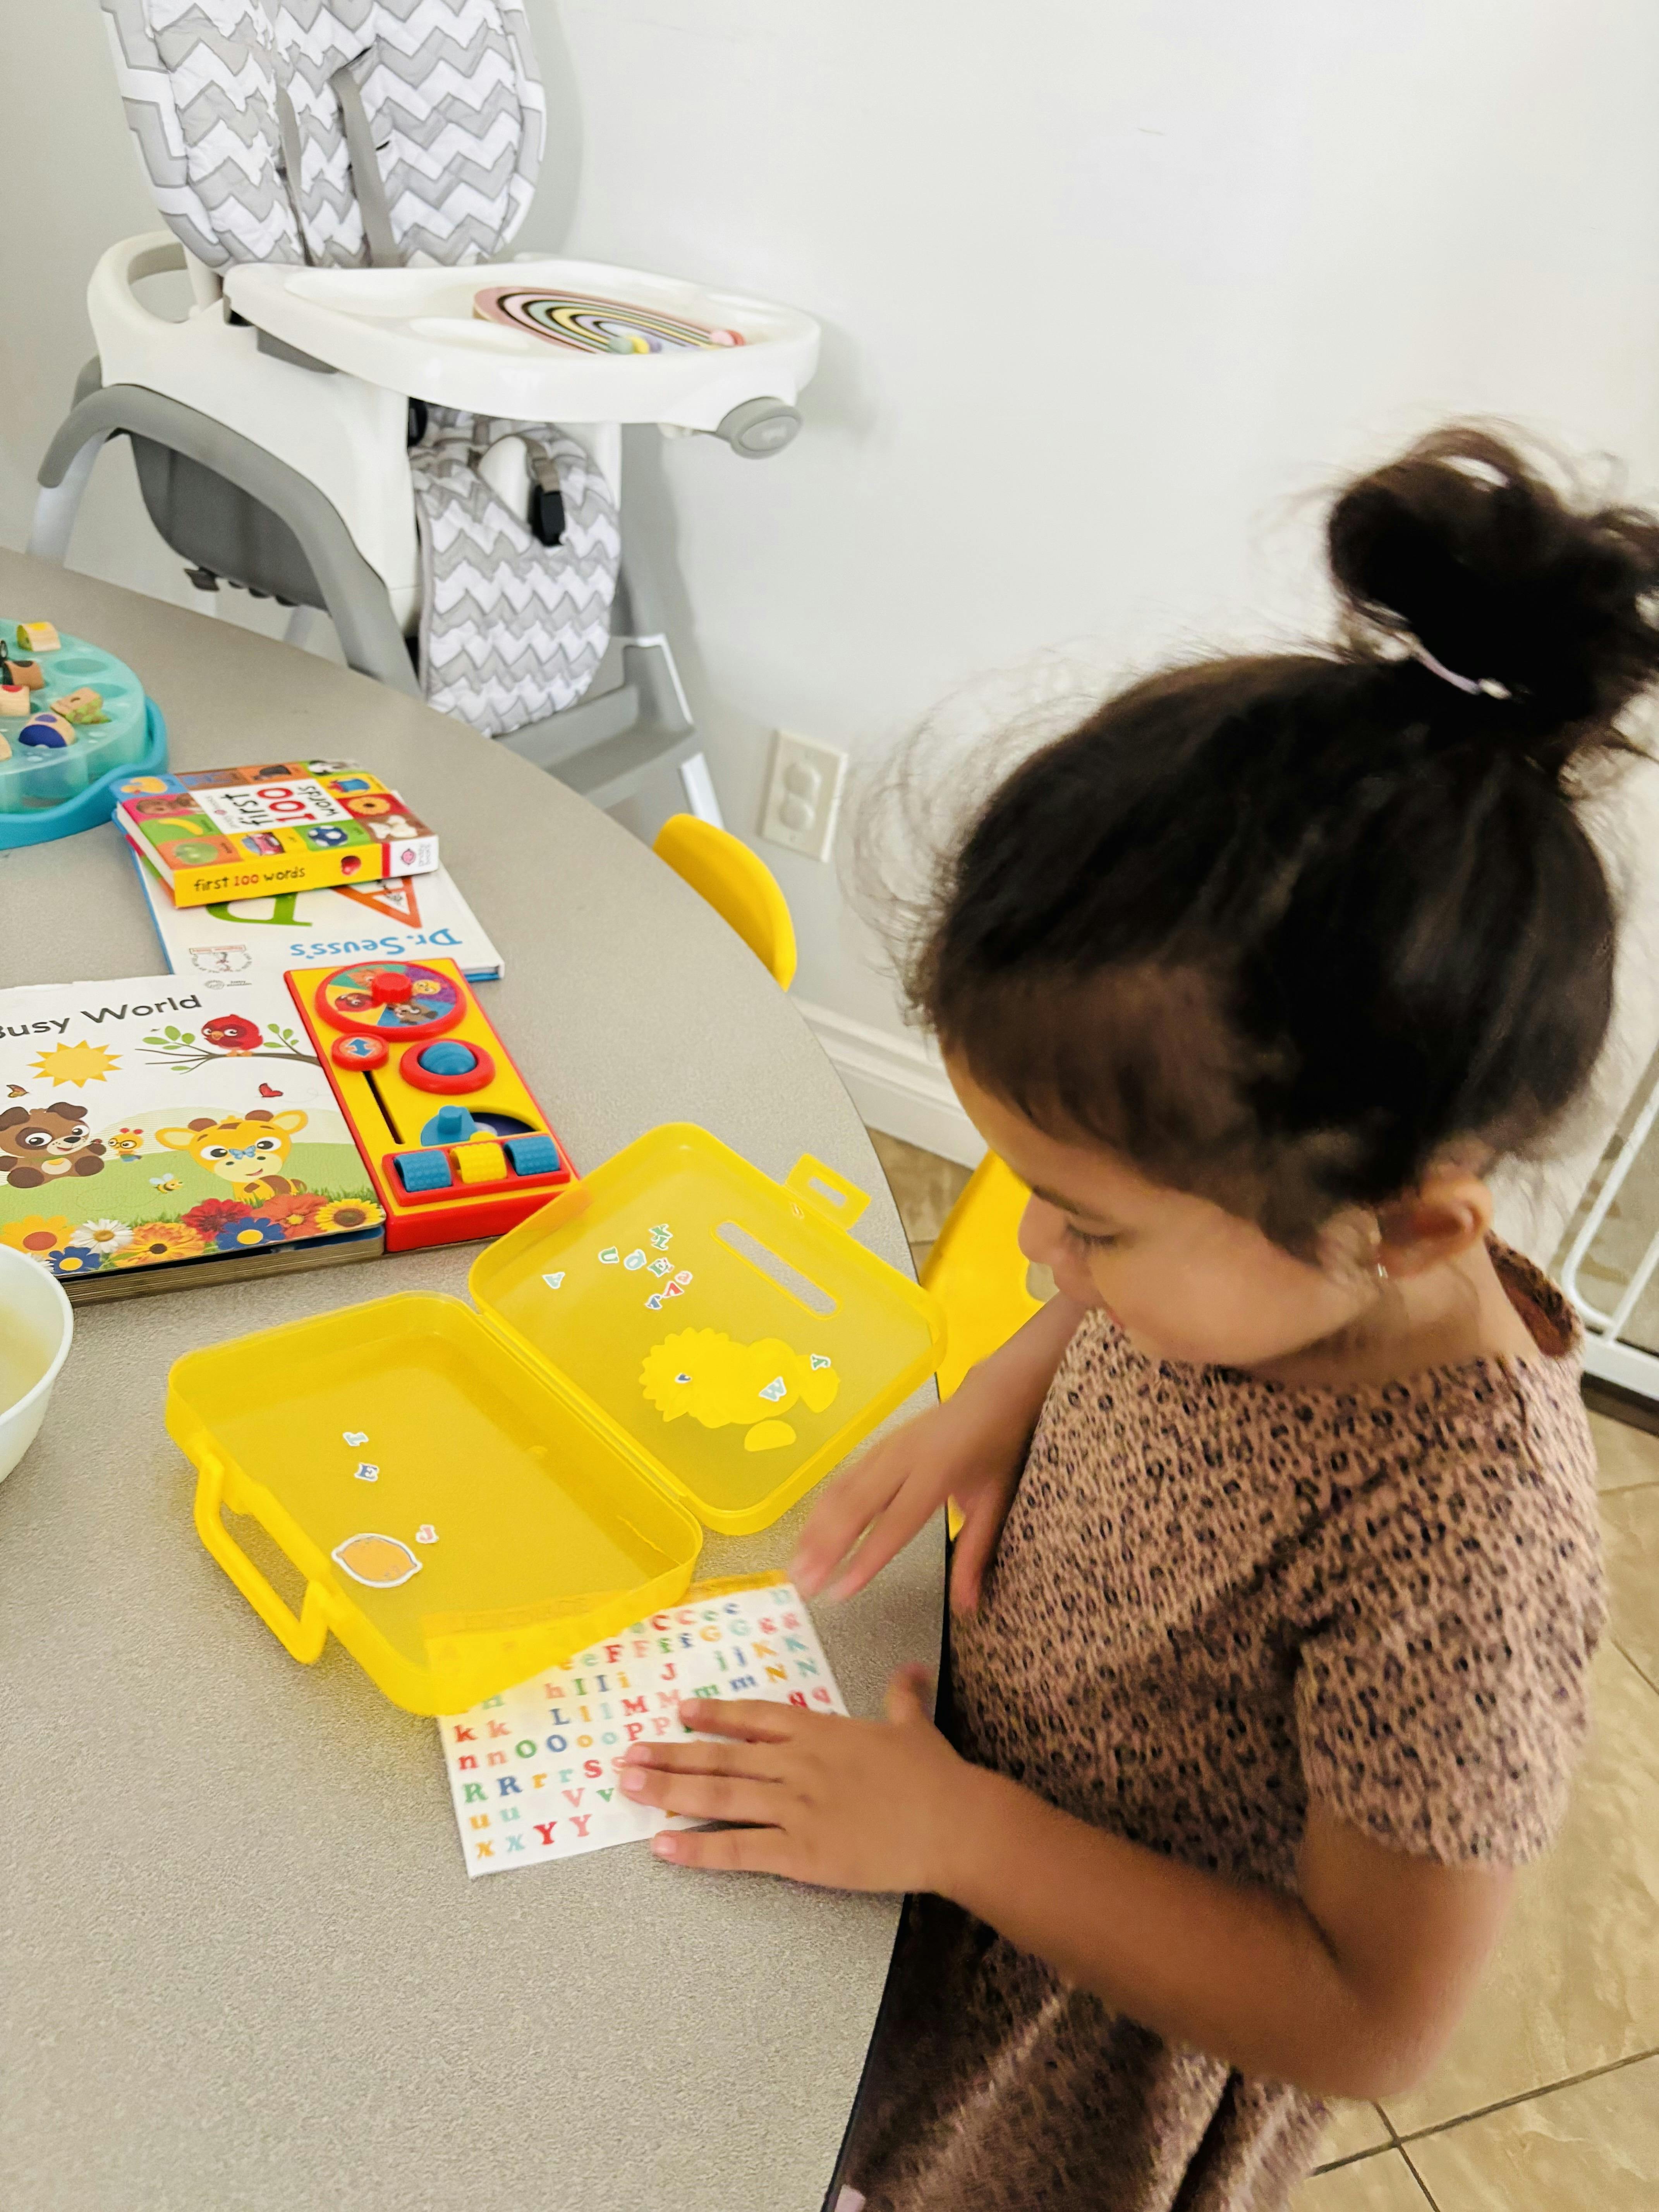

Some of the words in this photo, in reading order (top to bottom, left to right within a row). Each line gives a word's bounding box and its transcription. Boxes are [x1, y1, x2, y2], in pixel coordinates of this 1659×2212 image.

[220, 793, 274, 826] first
[257, 788, 316, 821] 100
[297, 786, 339, 817] words
[194, 878, 230, 891] first
[234, 874, 259, 886] 100
[263, 867, 306, 881] words
[290, 937, 405, 959] Seuss's
[406, 928, 463, 946] Dr.
[80, 994, 203, 1023] World
[603, 1644, 625, 1664] F
[660, 1663, 677, 1681] J
[453, 1724, 478, 1743] k
[486, 1719, 512, 1738] k
[549, 1708, 570, 1726] L
[621, 1695, 649, 1717] M
[458, 1755, 479, 1770] n
[486, 1750, 508, 1767] n
[623, 1722, 644, 1741] P
[651, 1716, 670, 1736] P
[463, 1782, 489, 1803] R
[496, 1775, 523, 1797] R
[469, 1813, 491, 1831] u
[500, 1807, 521, 1822] u
[532, 1821, 558, 1846] Y
[568, 1814, 593, 1838] Y
